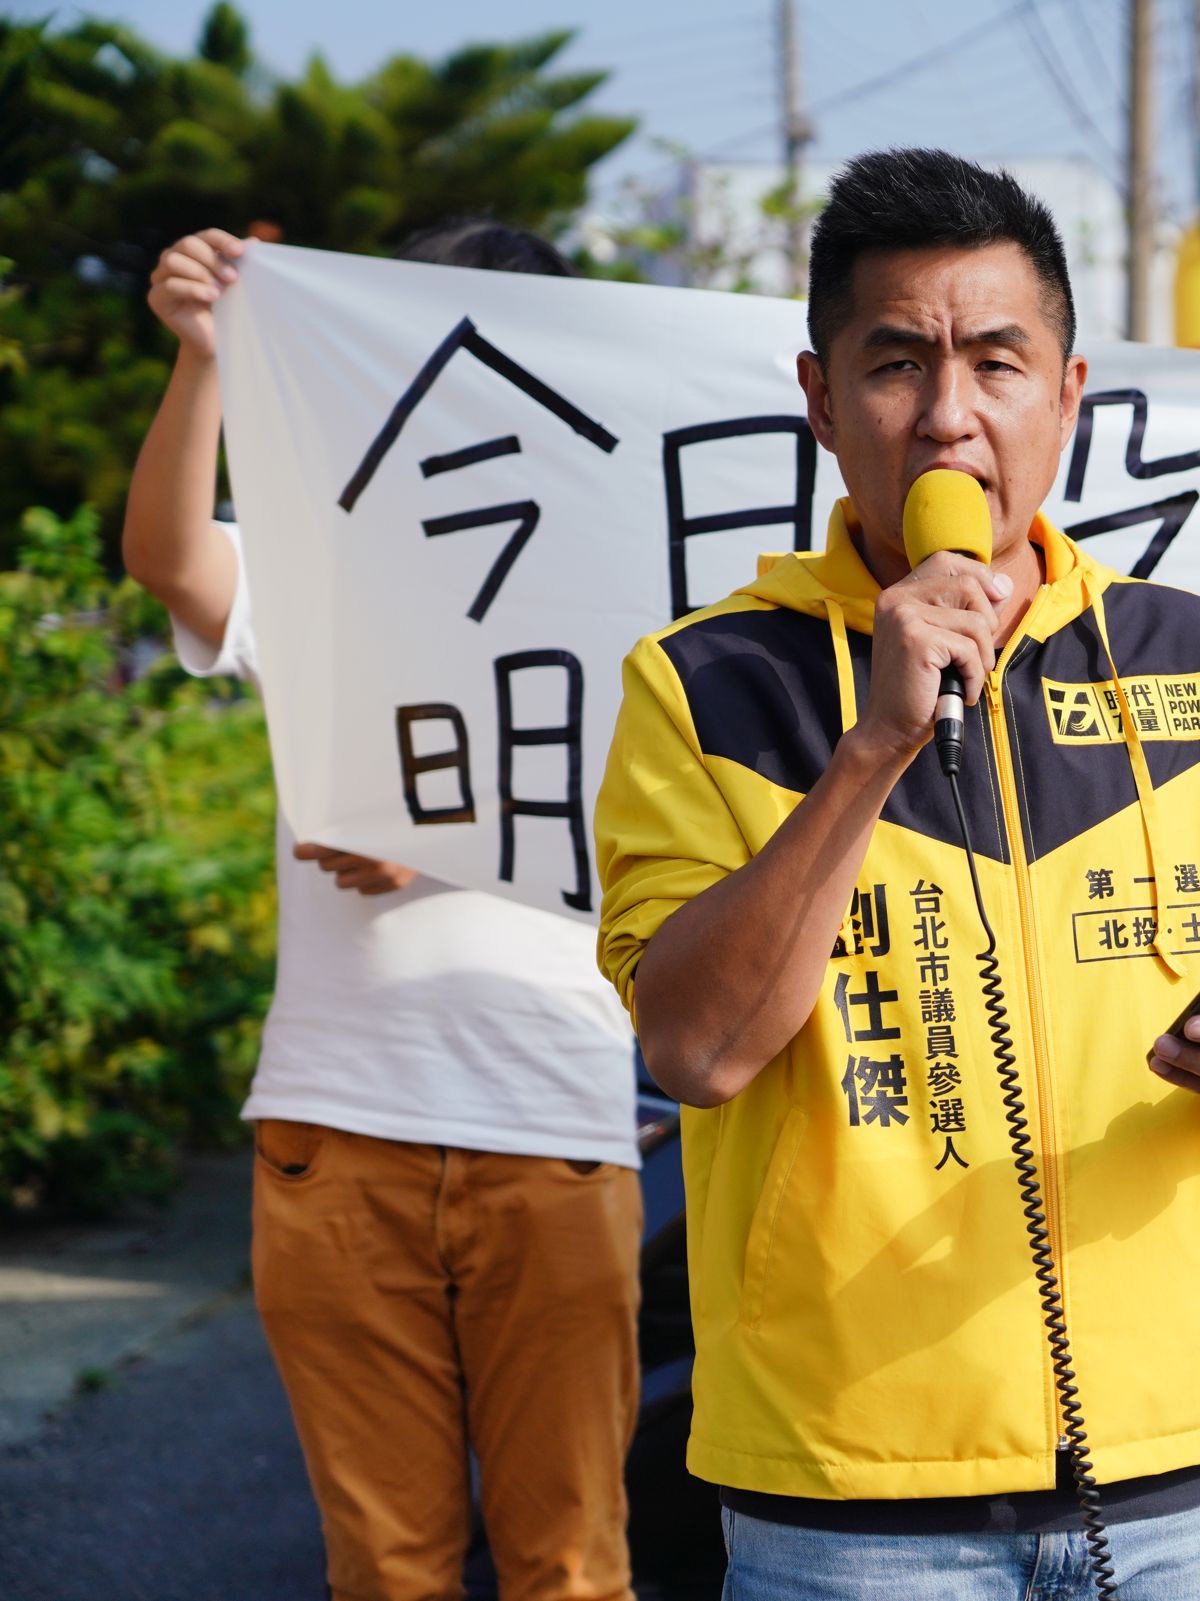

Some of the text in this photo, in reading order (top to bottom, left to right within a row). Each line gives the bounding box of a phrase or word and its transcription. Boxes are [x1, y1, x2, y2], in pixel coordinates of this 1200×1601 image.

[397, 648, 593, 912] 明
[1164, 682, 1198, 697] NEW
[909, 879, 969, 1171] 台北市議員參選人
